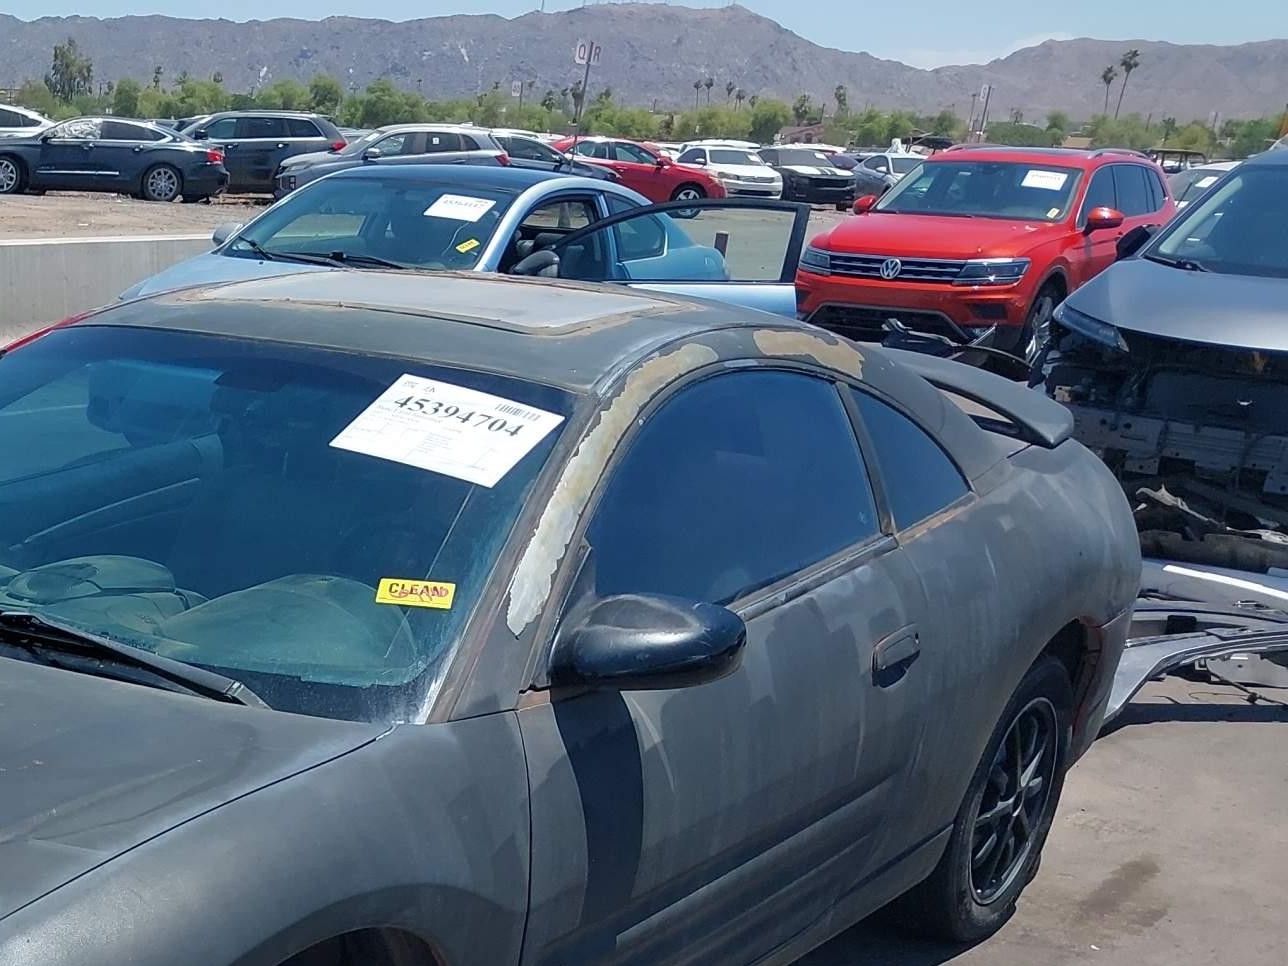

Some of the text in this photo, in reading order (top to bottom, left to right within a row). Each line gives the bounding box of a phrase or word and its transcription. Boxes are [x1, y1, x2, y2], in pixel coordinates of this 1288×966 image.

[578, 44, 587, 60] Q
[593, 46, 602, 62] R
[393, 395, 525, 437] 45394704
[388, 582, 443, 598] CLEAN
